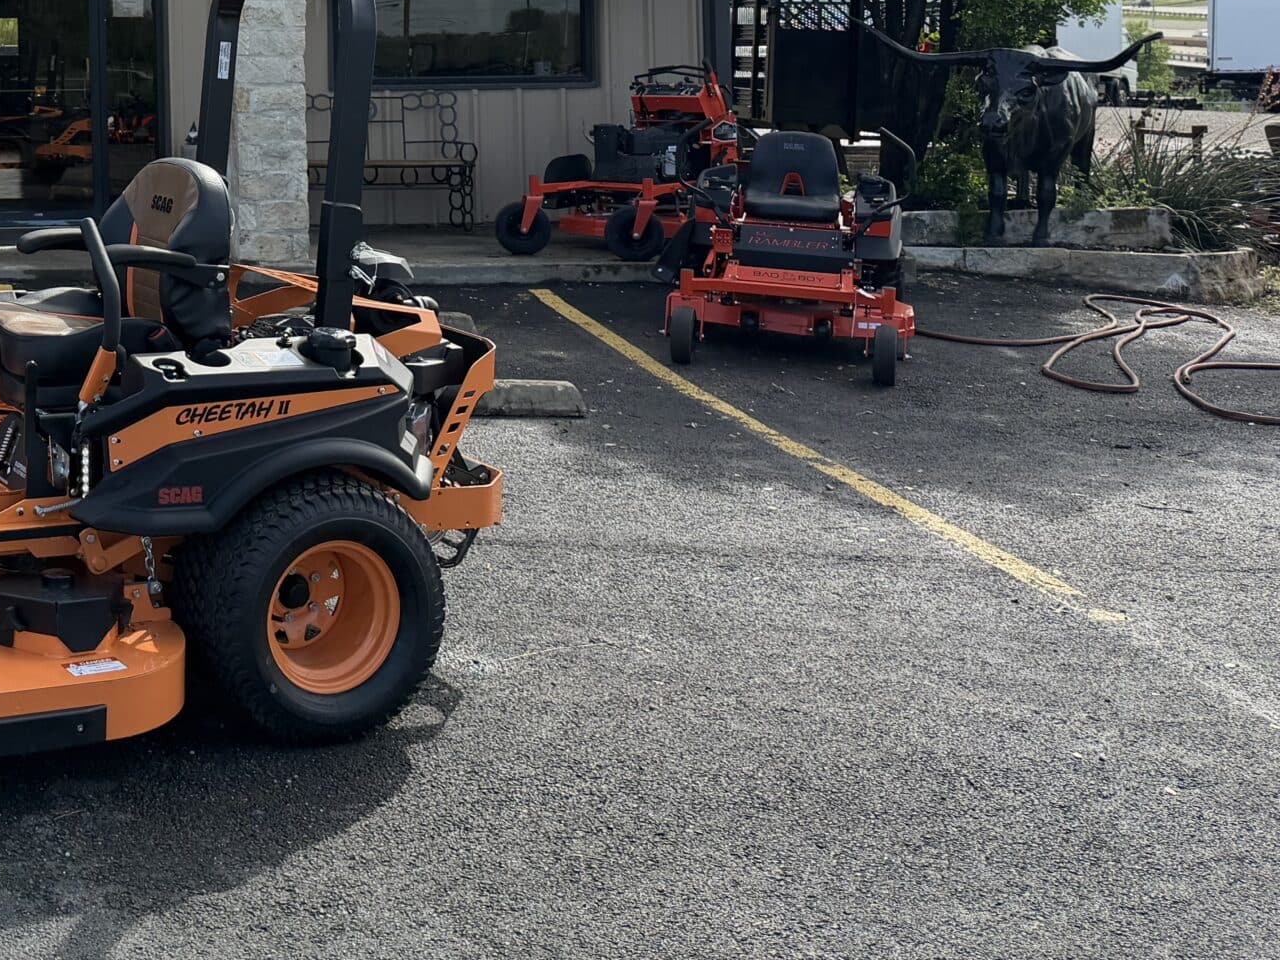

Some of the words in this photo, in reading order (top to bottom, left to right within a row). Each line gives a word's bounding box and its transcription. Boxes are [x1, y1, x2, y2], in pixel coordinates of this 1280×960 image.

[151, 194, 173, 214] SCAG
[748, 236, 830, 250] RAMBLER
[175, 400, 275, 426] CHEETAH
[277, 400, 291, 415] II
[158, 486, 203, 505] SCAG
